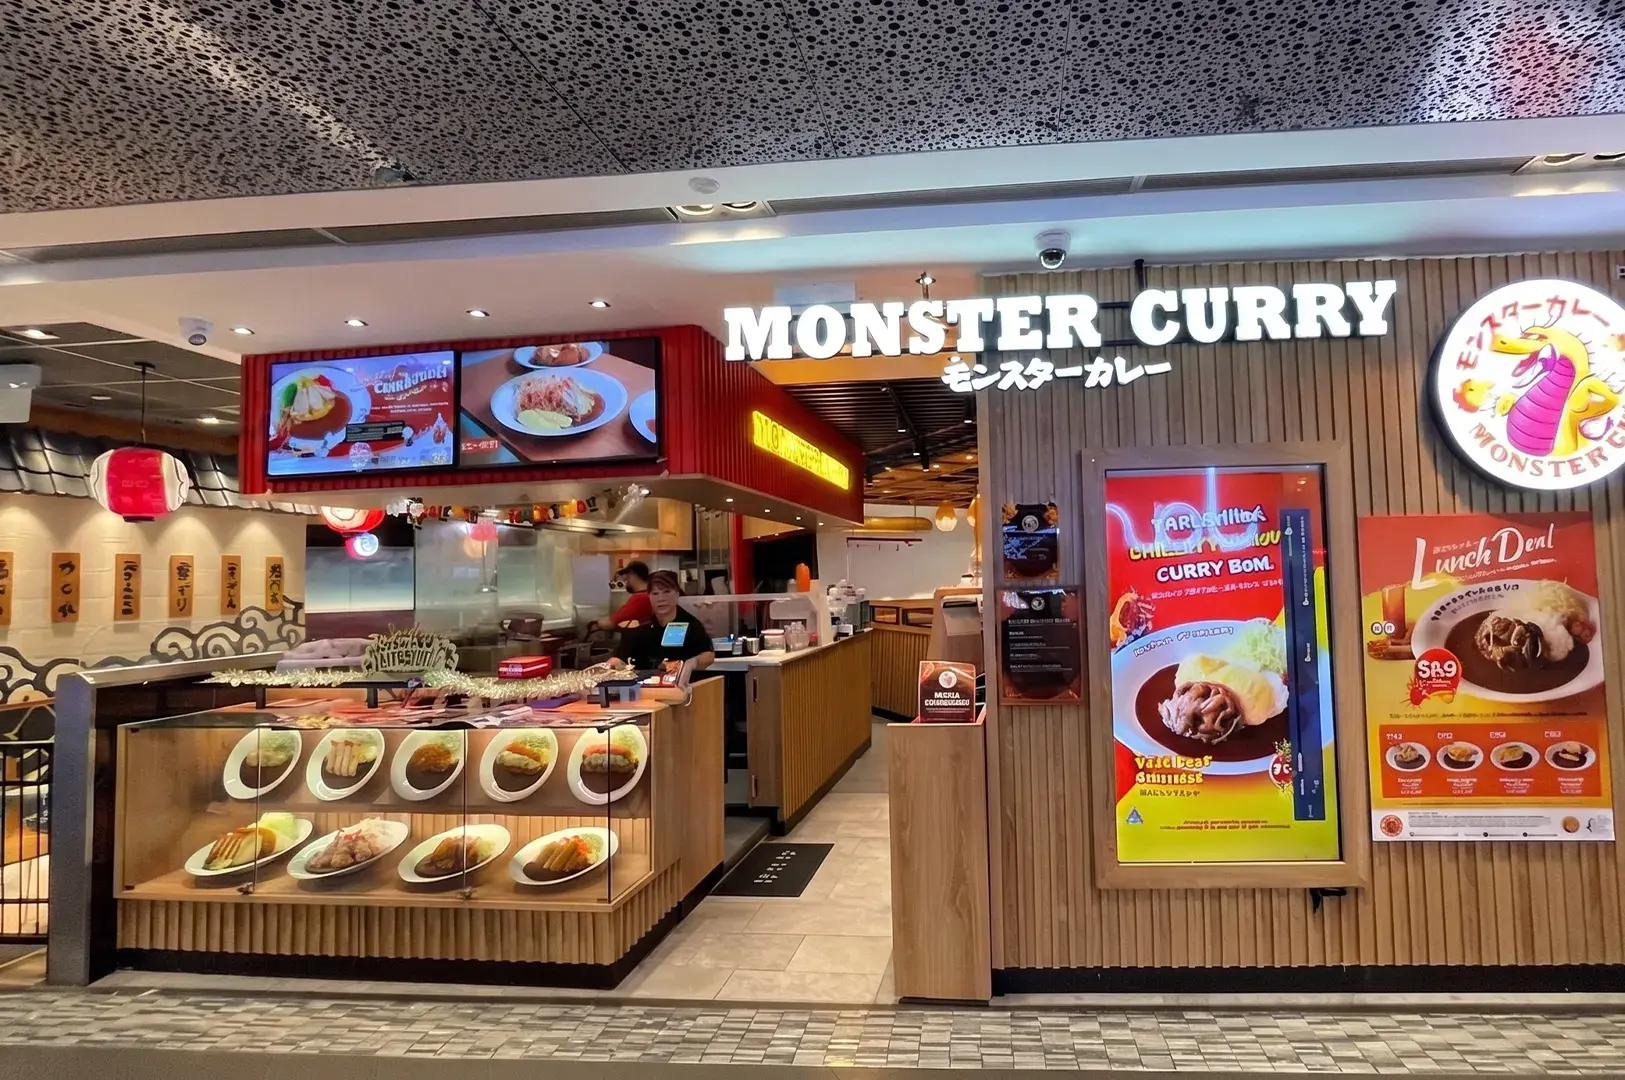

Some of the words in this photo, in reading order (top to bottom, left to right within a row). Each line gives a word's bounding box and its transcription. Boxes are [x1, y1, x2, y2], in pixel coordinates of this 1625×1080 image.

[724, 293, 1101, 361] MONSTER
[1130, 280, 1397, 346] CURRY
[941, 356, 1172, 393] モンスターカレー
[1469, 422, 1609, 478] MONSTER
[1156, 560, 1223, 582] CURRY
[1411, 537, 1491, 590] Lunch
